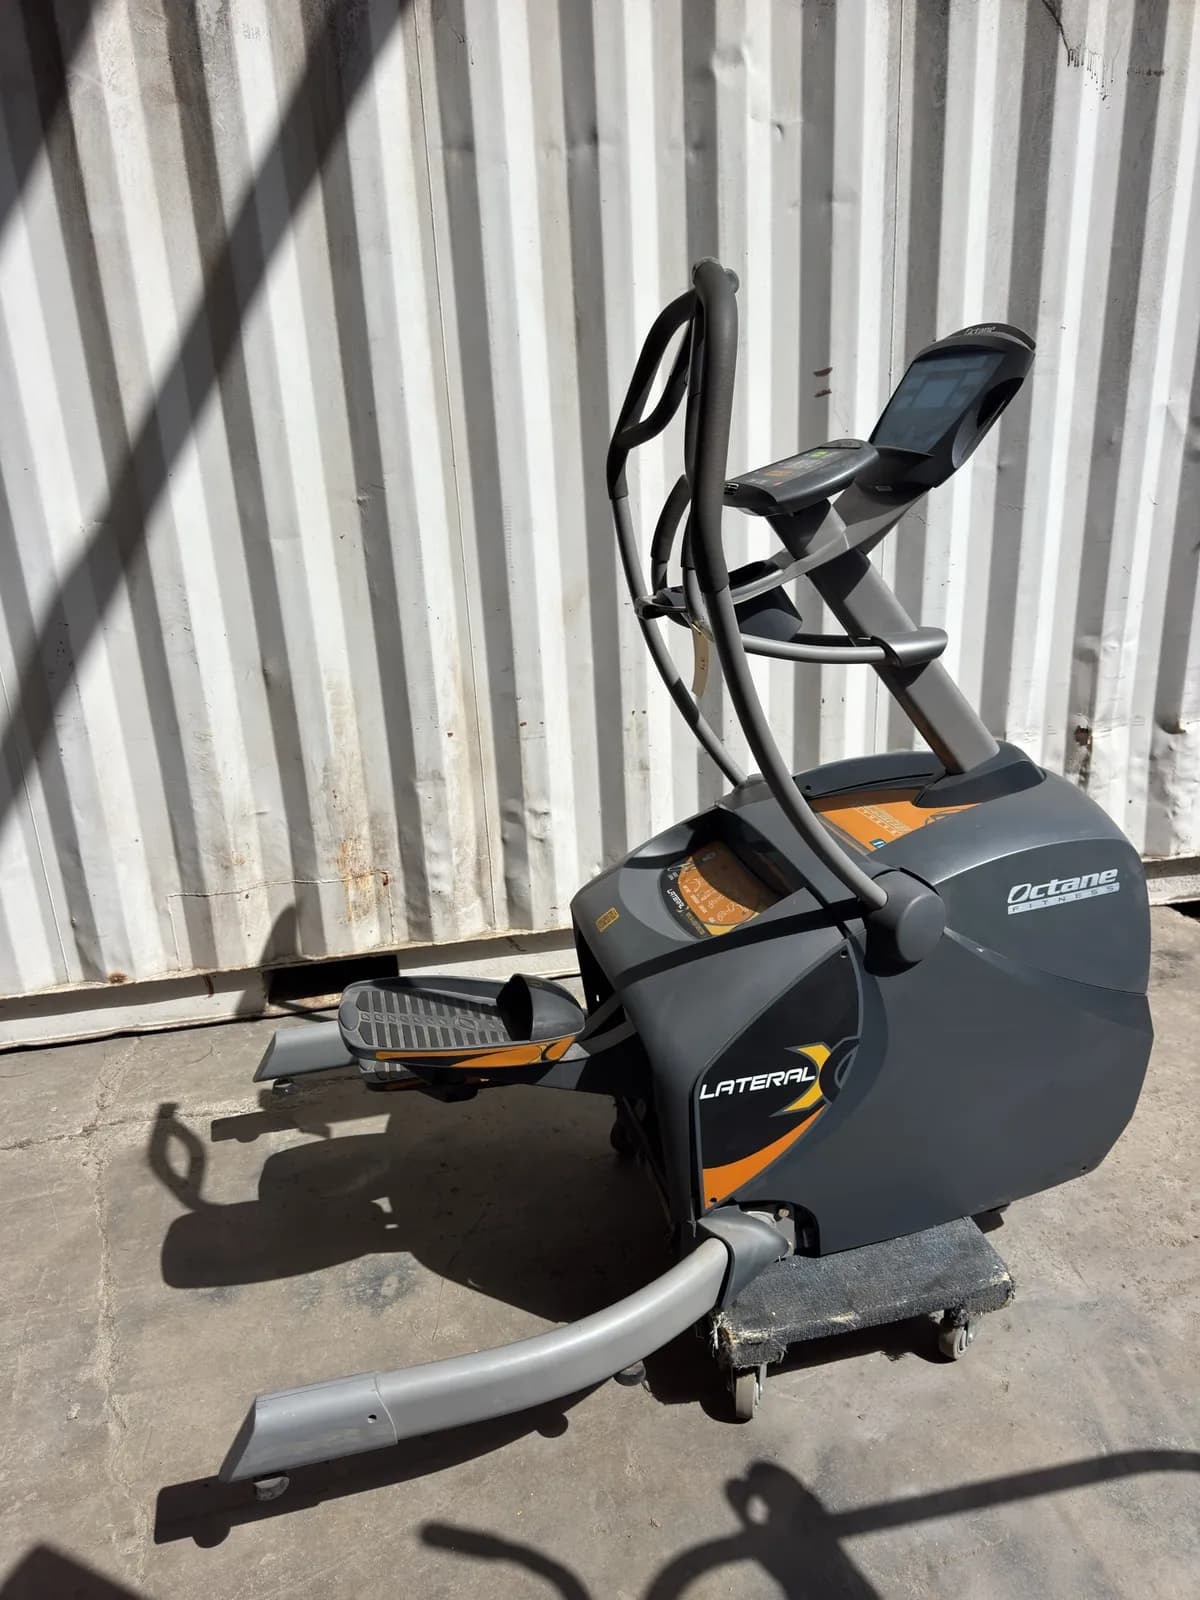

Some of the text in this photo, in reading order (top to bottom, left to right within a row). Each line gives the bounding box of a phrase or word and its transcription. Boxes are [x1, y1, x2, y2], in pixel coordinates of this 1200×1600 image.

[1007, 868, 1118, 904] Octane
[1008, 883, 1119, 914] FITNESS
[699, 1066, 816, 1100] LATERAL
